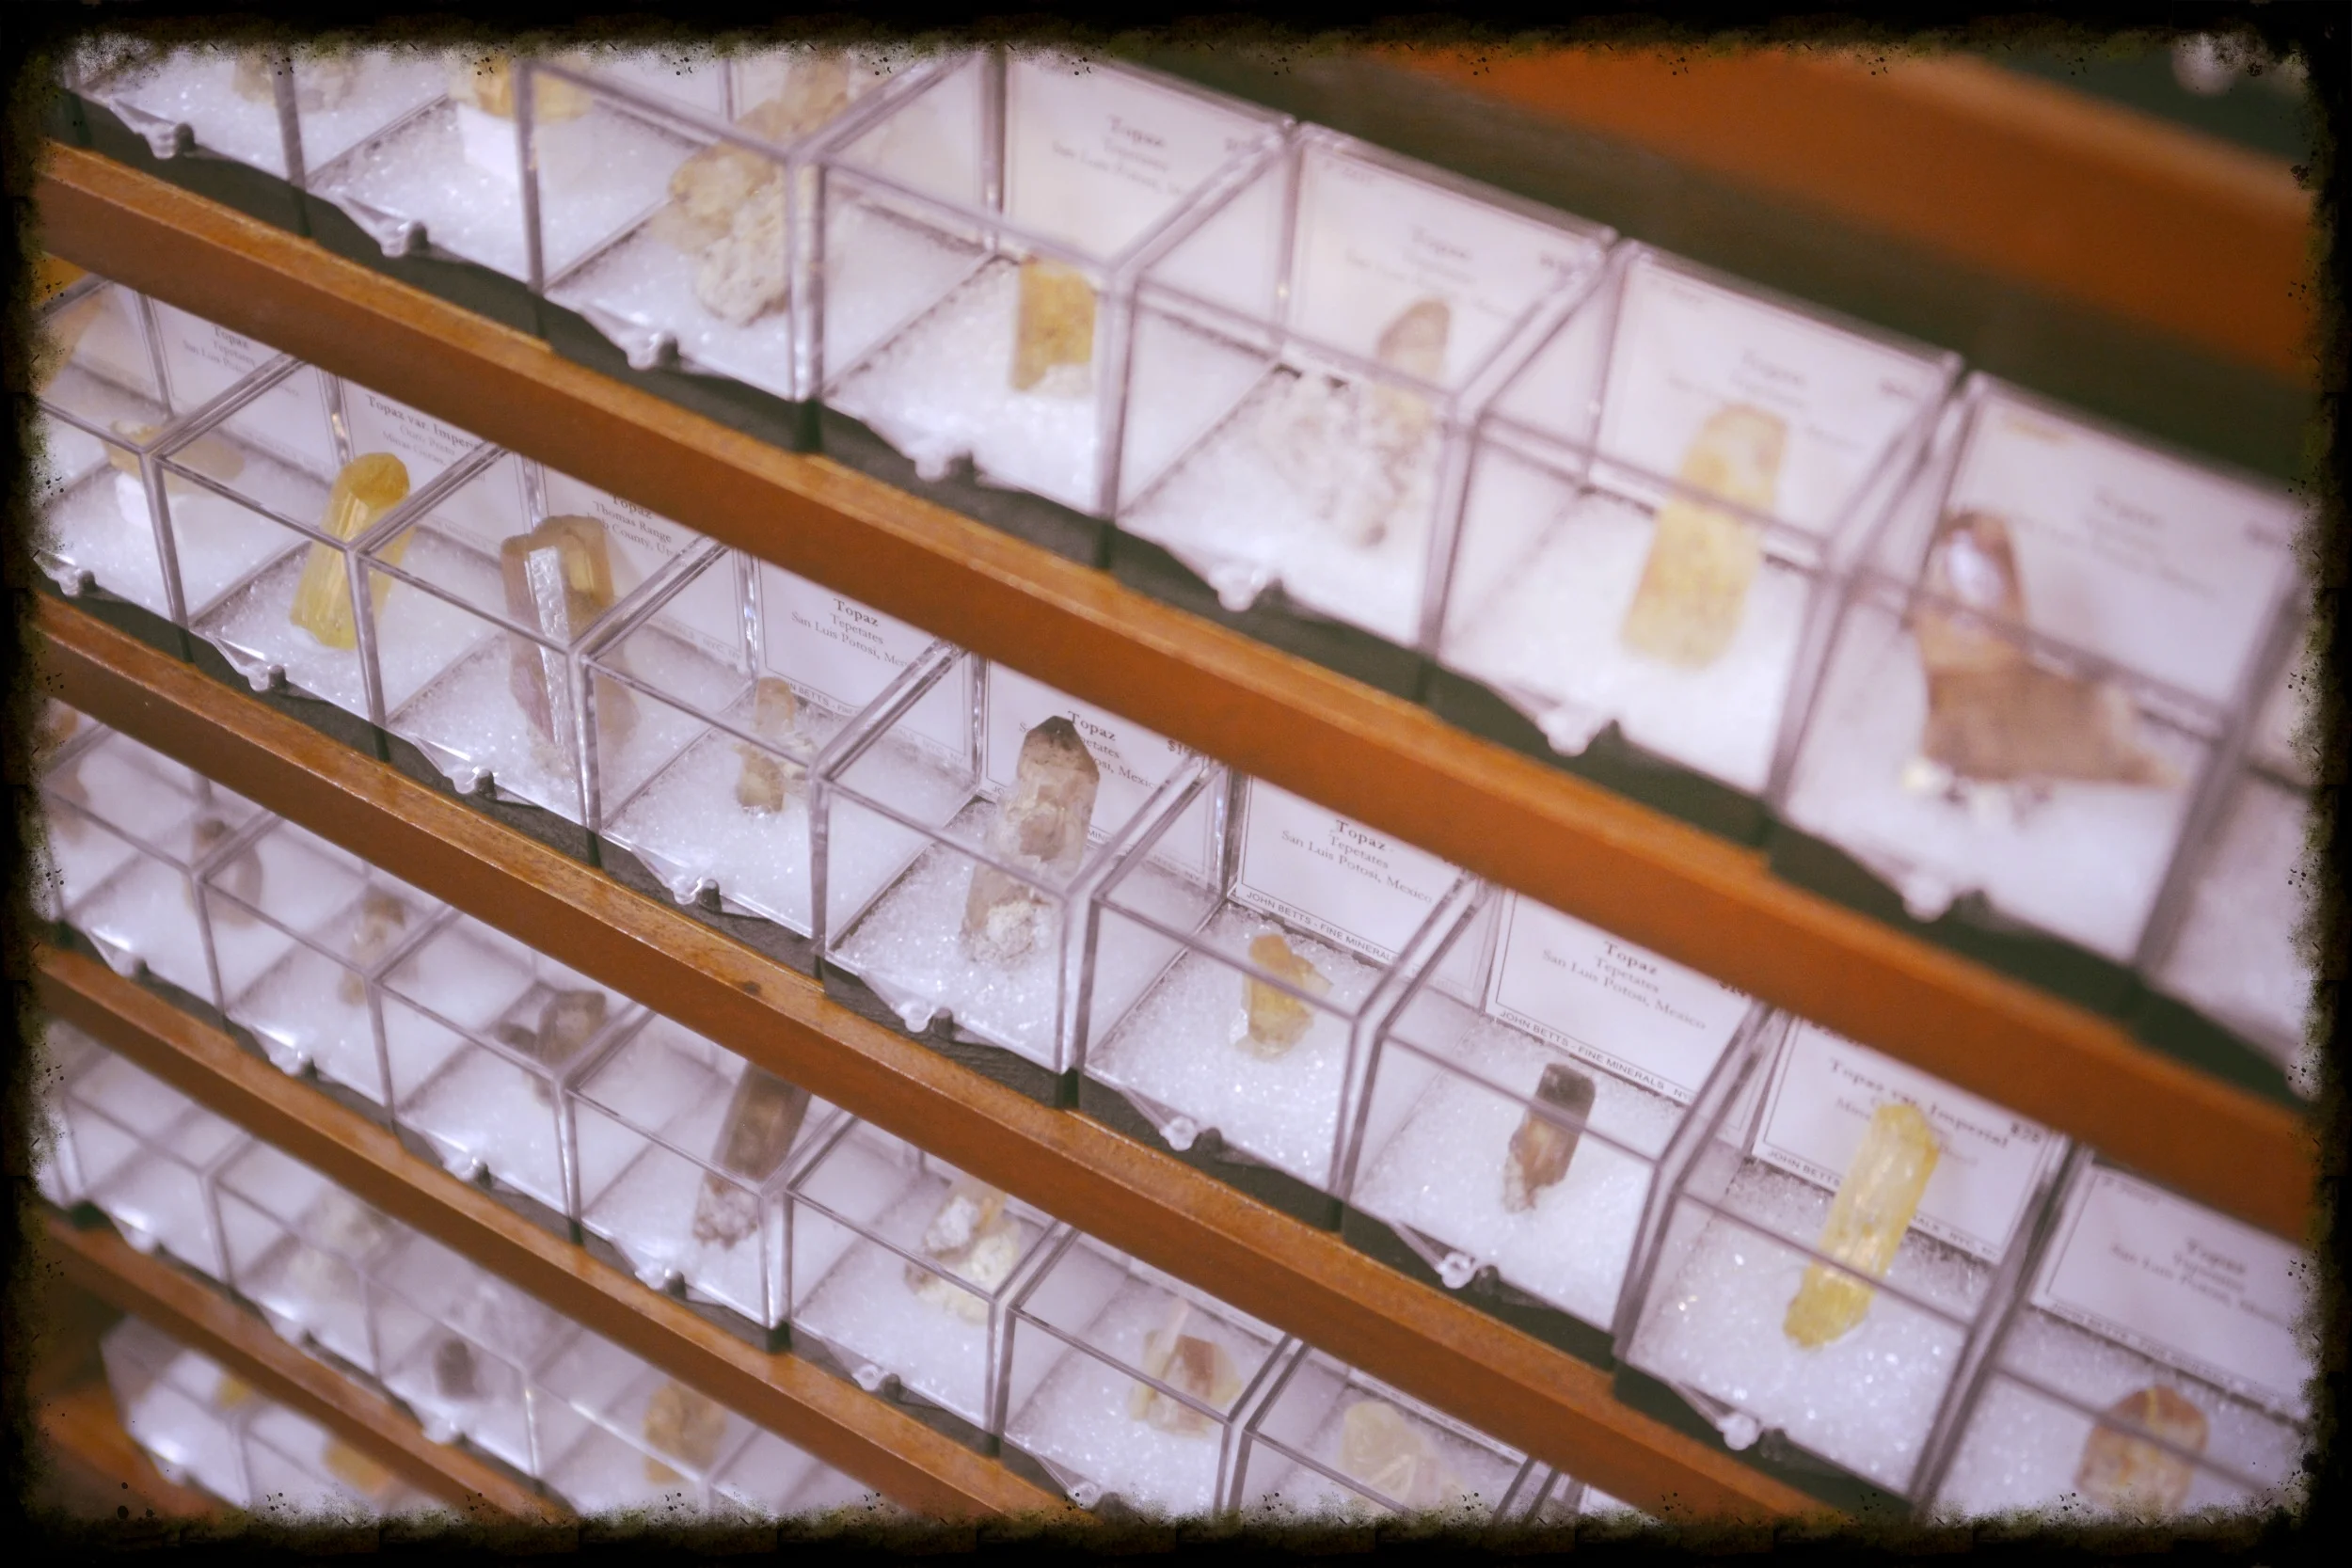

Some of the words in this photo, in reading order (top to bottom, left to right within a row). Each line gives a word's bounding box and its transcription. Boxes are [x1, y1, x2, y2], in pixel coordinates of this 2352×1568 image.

[366, 393, 405, 420] Topaz
[592, 500, 636, 528] Thomas
[640, 520, 673, 544] Range
[609, 493, 653, 520] Topaz
[612, 524, 654, 552] County,
[829, 612, 883, 645] Tepetates
[834, 597, 879, 627] Topaz
[791, 611, 811, 629] San
[815, 621, 837, 641] Luis
[841, 633, 881, 660] Potosi,
[799, 686, 829, 706] BETTS
[1067, 710, 1116, 742] Topaz
[1329, 834, 1390, 869] Tepetates
[1336, 818, 1387, 851] Topaz
[1280, 830, 1304, 848] San
[1309, 842, 1334, 862] Luis
[1338, 854, 1382, 884] Potosi,
[1386, 874, 1433, 904] Mexico
[1246, 892, 1276, 910] JOHN
[1278, 904, 1311, 926] BETTS
[1320, 923, 1343, 941] FINE
[1595, 956, 1660, 993] Tepetates
[1603, 941, 1659, 976] Topaz
[1541, 949, 1566, 969] San
[1571, 963, 1599, 984] Luis
[1655, 999, 1707, 1031] Mexico
[1500, 1011, 1532, 1031] JOHN
[1533, 1024, 1570, 1048] BETTS
[1578, 1045, 1604, 1064] FINE
[1605, 1056, 1664, 1091] MINERALS
[1767, 1148, 1802, 1172] JOHN
